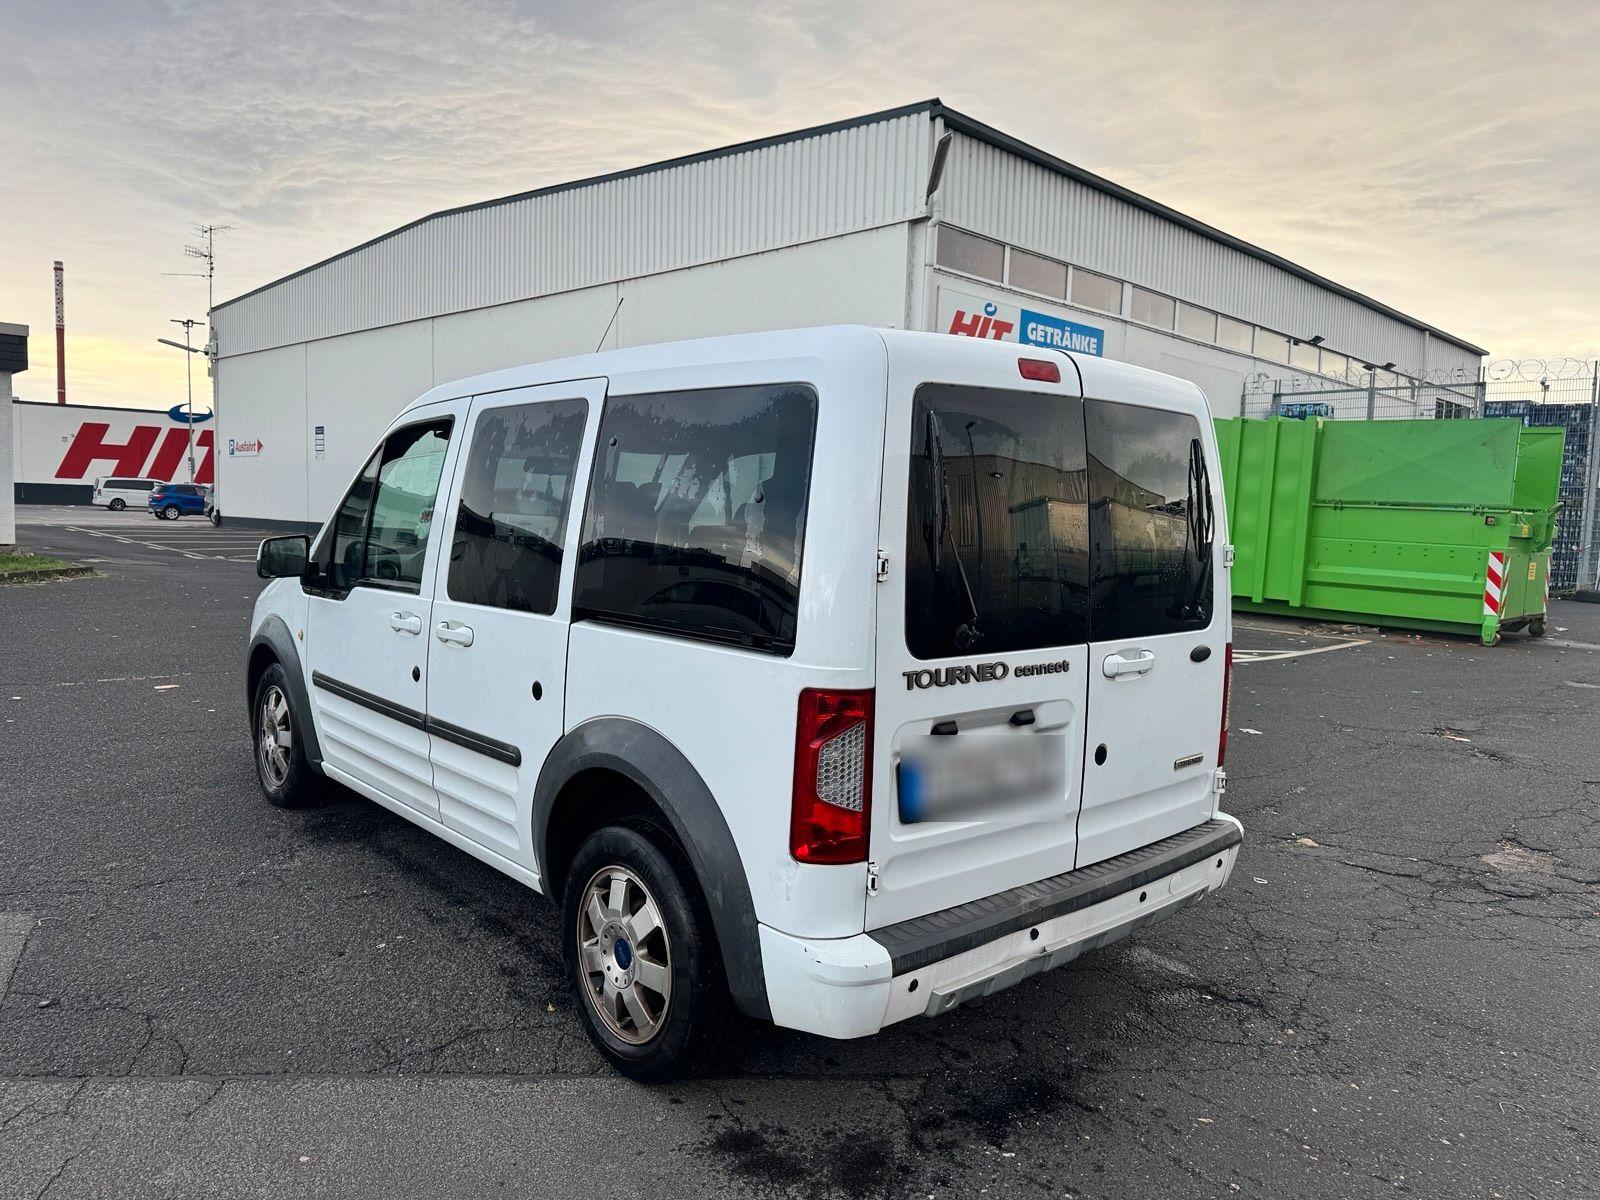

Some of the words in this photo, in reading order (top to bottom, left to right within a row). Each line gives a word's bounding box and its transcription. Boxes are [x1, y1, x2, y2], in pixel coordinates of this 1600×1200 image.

[949, 309, 1014, 341] HIT
[1027, 322, 1098, 355] GETRÄNKE
[236, 441, 256, 452] Ausfahrt
[902, 661, 1010, 691] TOURNEO
[1014, 659, 1070, 678] connect
